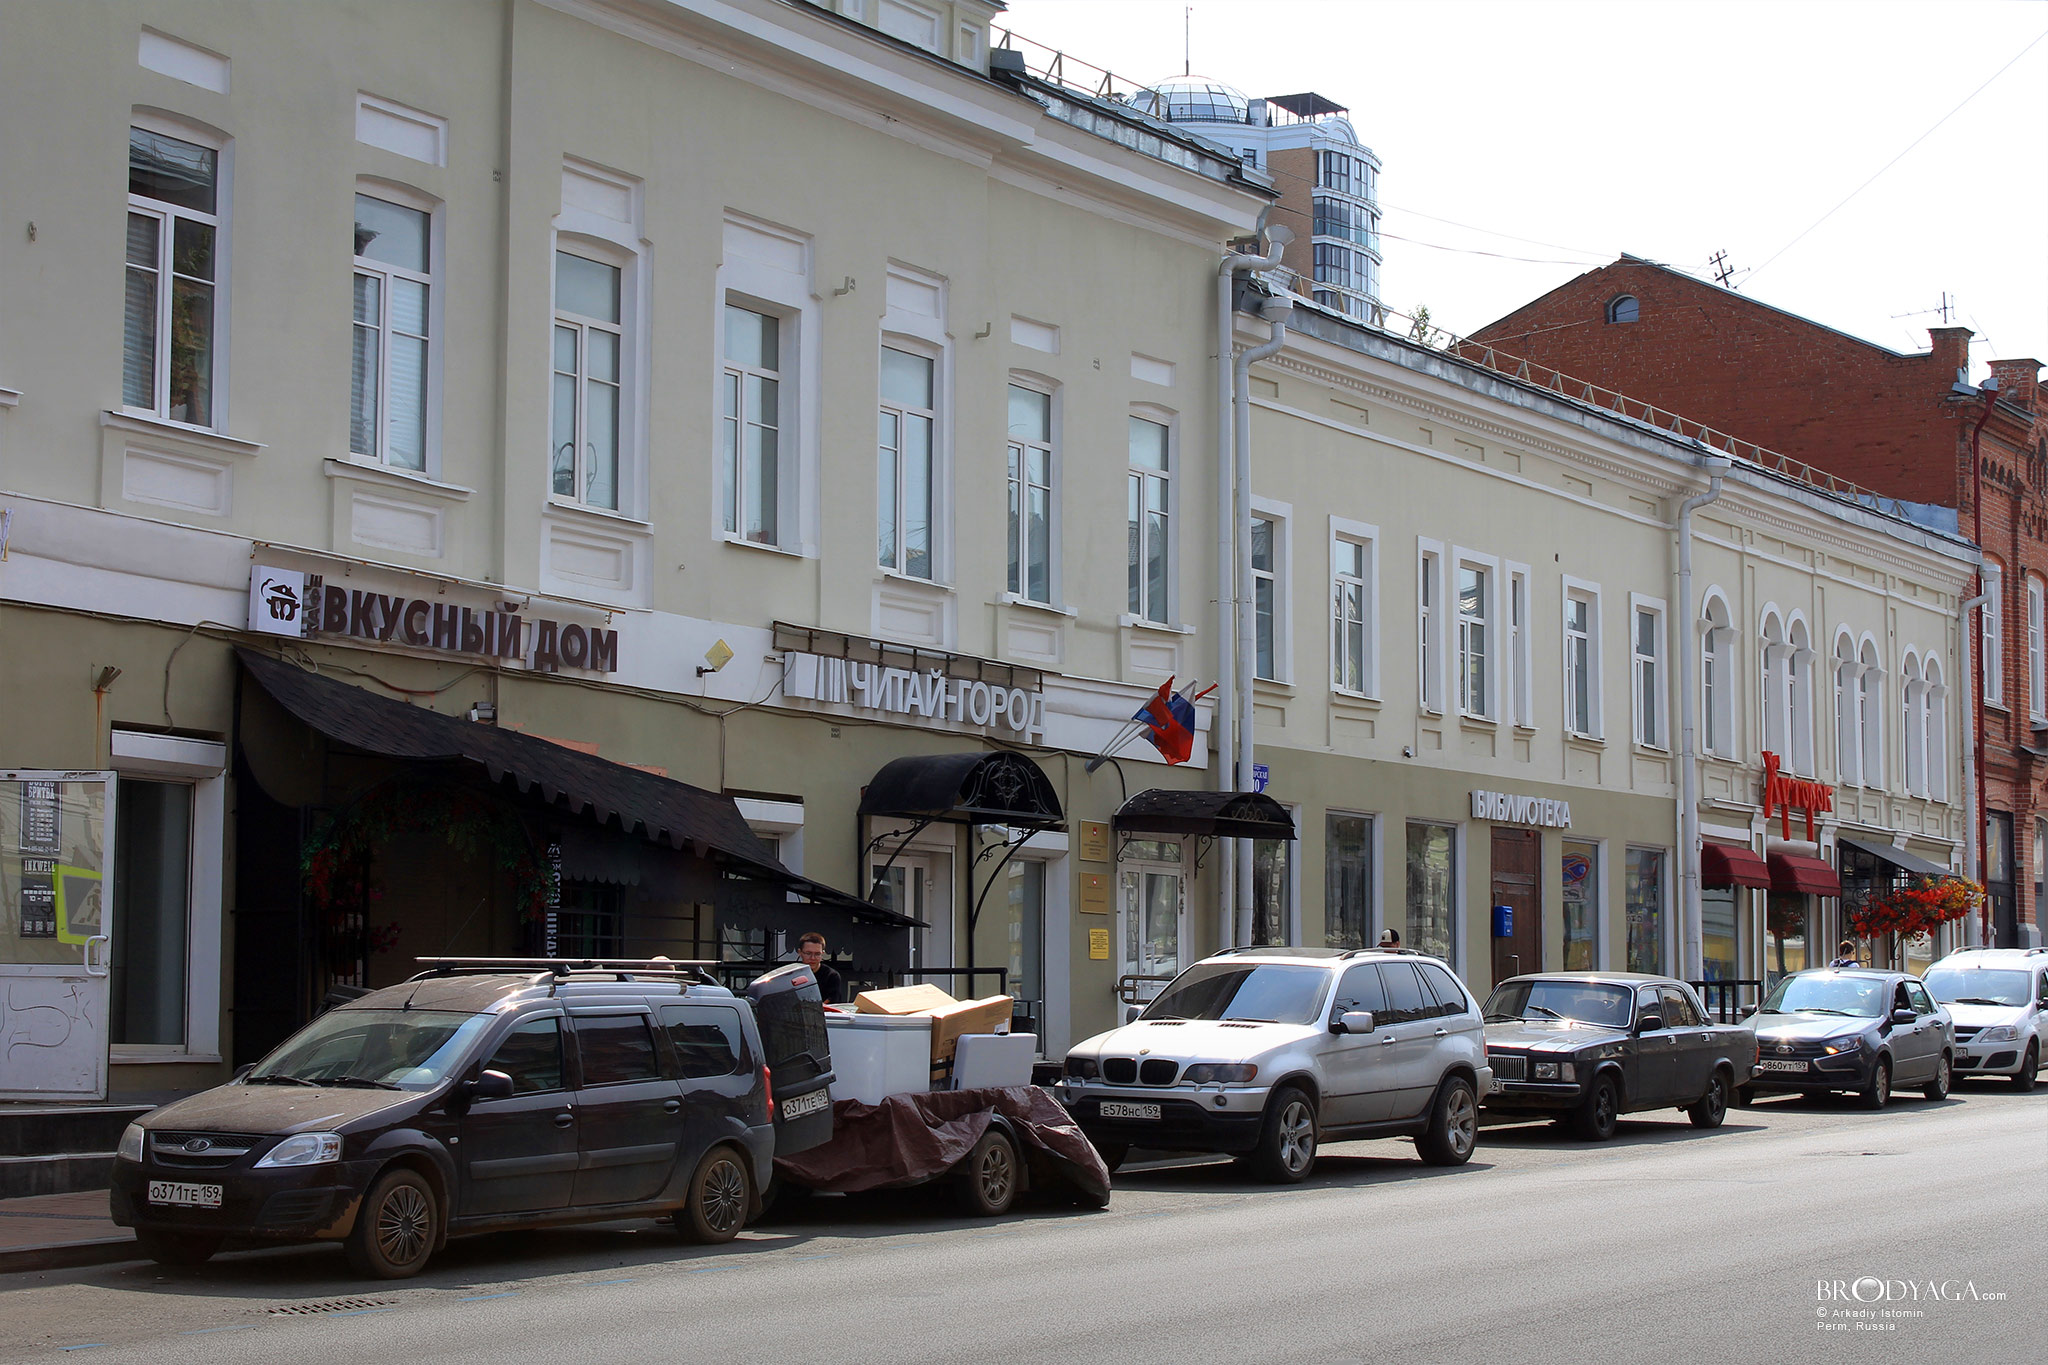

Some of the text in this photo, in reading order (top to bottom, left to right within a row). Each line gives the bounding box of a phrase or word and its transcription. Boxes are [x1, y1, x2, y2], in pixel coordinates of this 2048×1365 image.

[304, 574, 323, 640] КАФЕ
[323, 584, 618, 673] ВКУСНЫЙ ДОМ
[851, 661, 1046, 745] ЧИТАЙ-ГОРОД
[28, 786, 55, 799] БРИТВА
[1474, 790, 1572, 828] БИБЛИОТЕКА
[24, 860, 55, 872] INKWELL
[1103, 1104, 1158, 1117] Е578НС 159
[152, 1183, 219, 1202] О371ТЕ 159
